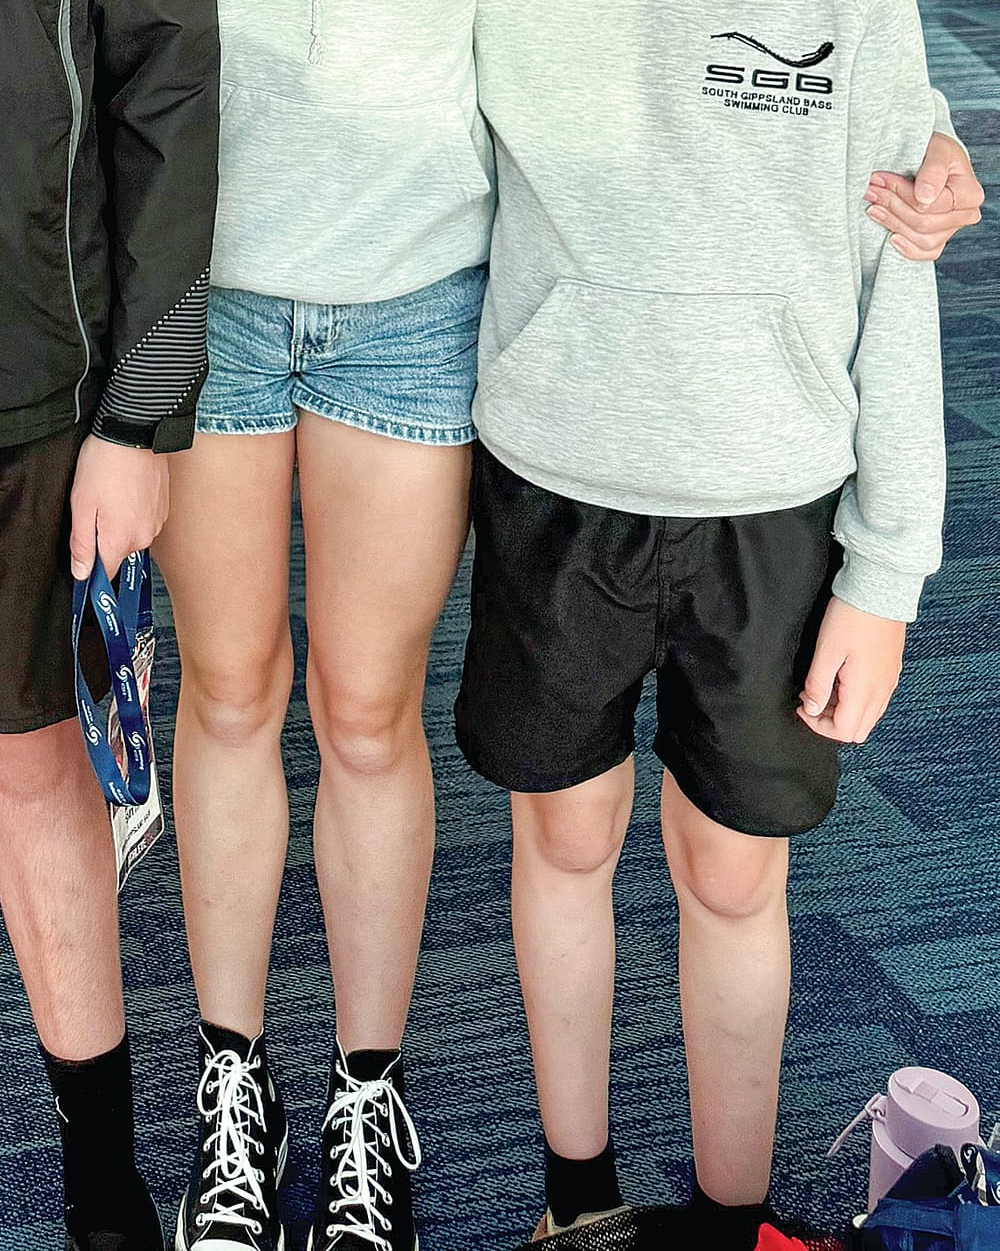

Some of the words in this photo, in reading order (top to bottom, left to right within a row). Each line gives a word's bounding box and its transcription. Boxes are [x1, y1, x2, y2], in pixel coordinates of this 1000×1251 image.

[704, 63, 833, 94] SGB
[701, 86, 738, 99] SOUTH
[740, 91, 801, 106] GIPPSLAND
[803, 98, 833, 110] BASS
[723, 99, 779, 113] SWIMMING
[781, 105, 809, 116] CLUB
